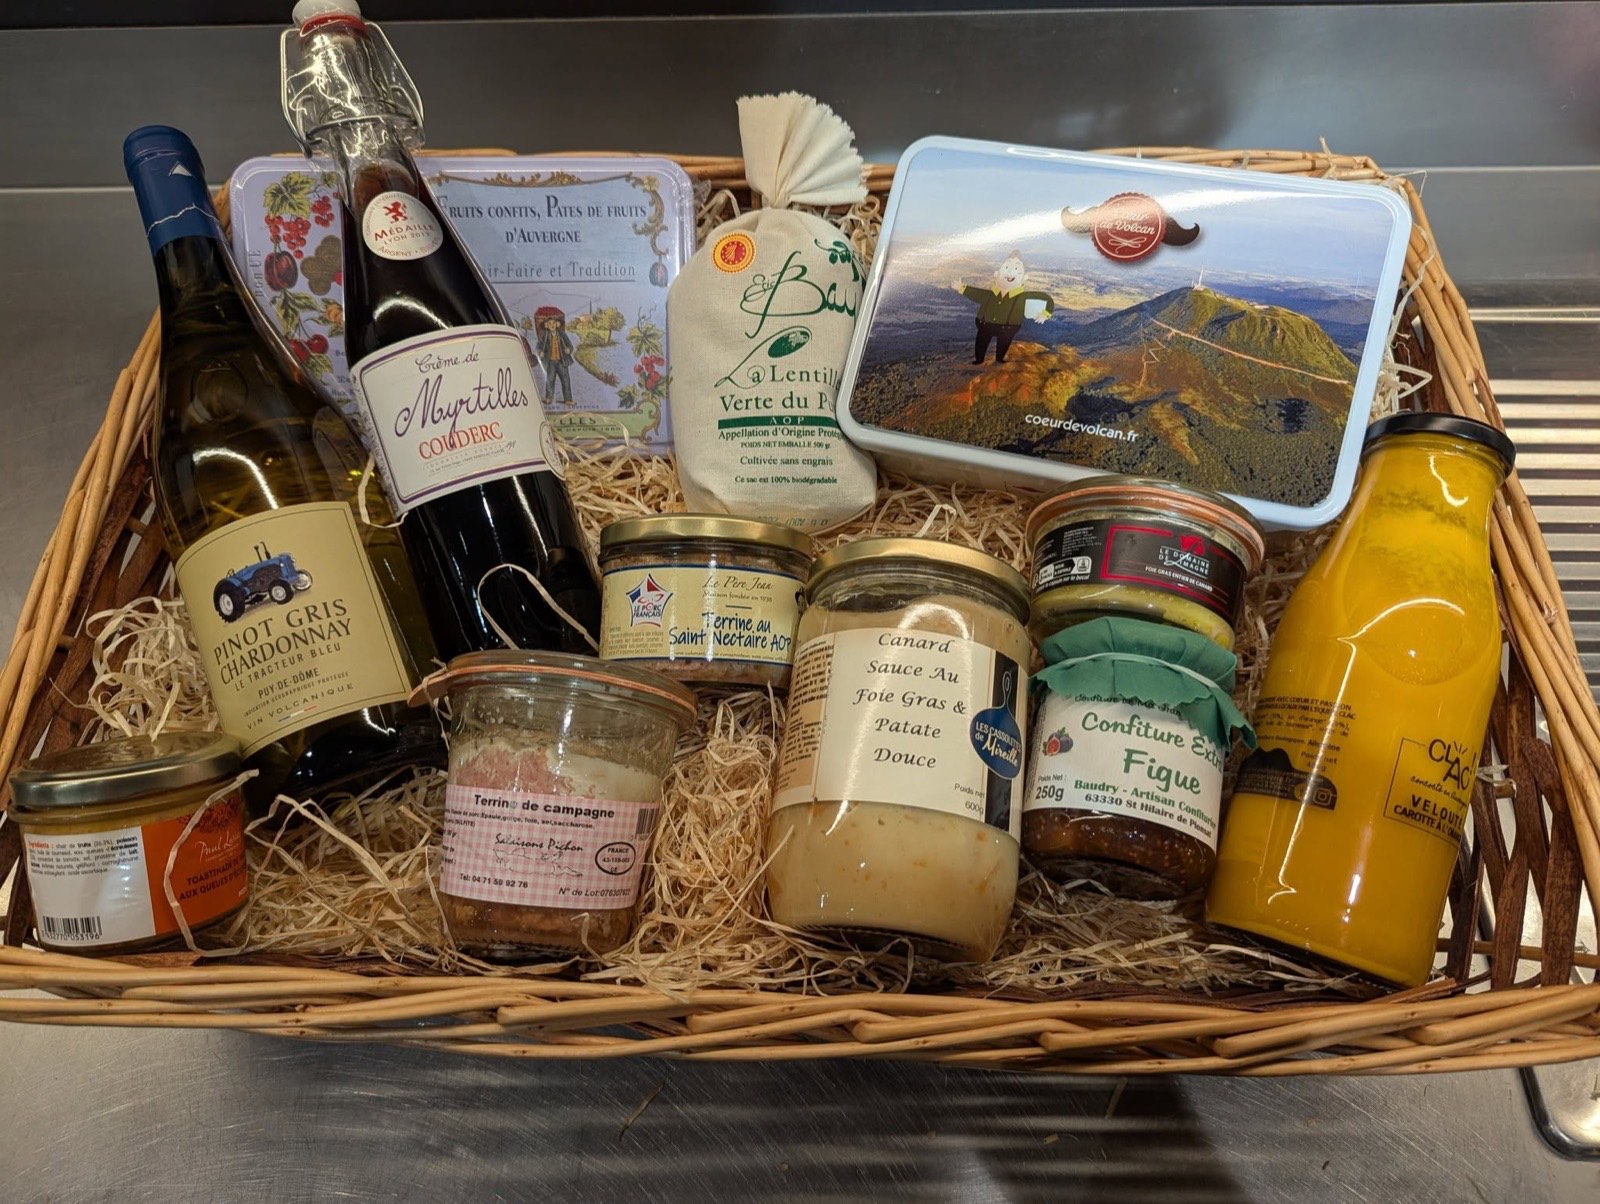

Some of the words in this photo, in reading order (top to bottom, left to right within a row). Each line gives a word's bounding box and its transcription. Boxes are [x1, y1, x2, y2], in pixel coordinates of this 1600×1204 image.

[1099, 219, 1113, 229] de
[1115, 220, 1155, 235] Volcan
[383, 234, 407, 245] LYON
[378, 245, 412, 257] ARGENT
[550, 264, 563, 277] et
[567, 260, 636, 277] Tradition
[415, 353, 461, 374] Crème
[462, 343, 480, 364] de
[394, 367, 529, 449] Myrtilles
[720, 394, 773, 412] Verte
[781, 391, 809, 410] du
[718, 426, 769, 442] Appellation
[771, 426, 816, 440] d'Origine
[1025, 413, 1139, 443] coeurdevolcan.fr
[418, 421, 504, 460] COUDERC
[739, 456, 778, 466] Cultivée
[780, 457, 799, 466] sans
[801, 457, 833, 467] engrais
[734, 475, 746, 483] Ce
[791, 476, 838, 486] biodégradable
[745, 576, 773, 592] Jean
[1145, 565, 1157, 574] FOIE
[1157, 568, 1172, 577] GRAS
[1172, 571, 1189, 583] ENTIER
[729, 591, 750, 600] fondée
[213, 618, 274, 666] PINOT
[285, 598, 348, 628] GRIS
[702, 611, 753, 632] Terrine
[757, 620, 771, 634] au
[669, 627, 707, 645] Saint
[712, 630, 768, 650] Nectaire
[770, 633, 791, 653] AOP
[878, 631, 957, 654] Canard
[220, 618, 351, 685] CHARDONNAY
[234, 679, 245, 692] LE
[248, 653, 304, 684] TRACTEUR
[310, 642, 341, 659] BLEU
[866, 660, 923, 678] Sauce
[928, 666, 960, 684] Au
[247, 716, 264, 731] VIN
[268, 683, 354, 718] VOLCANIQUE
[852, 688, 895, 706] Foie
[901, 690, 947, 711] Gras
[952, 700, 968, 715] &
[875, 717, 942, 739] Patate
[976, 721, 989, 734] LES
[1081, 712, 1185, 749] Confiture
[873, 747, 937, 769] Douce
[975, 731, 984, 742] de
[982, 733, 1019, 768] Mireille
[1052, 774, 1063, 782] Net
[1123, 747, 1201, 795] Figue
[954, 782, 974, 796] Poids
[974, 789, 986, 799] net
[1035, 785, 1065, 802] 250g
[1074, 779, 1119, 796] Baudry
[1130, 787, 1176, 808] Artisan
[521, 799, 540, 812] de
[543, 804, 616, 820] campagne
[964, 800, 985, 816] 600g
[1085, 793, 1123, 807] 63330
[1125, 799, 1138, 810] St
[1140, 804, 1174, 821] Hilaire
[1176, 813, 1188, 826] de
[1393, 805, 1437, 828] CAROTTE
[179, 887, 199, 901] AUX
[199, 876, 230, 895] QUEUES
[460, 872, 472, 883] Tel:
[471, 874, 481, 884] 04
[482, 876, 492, 886] 71
[505, 878, 517, 889] 92
[518, 879, 529, 889] 76
[558, 886, 571, 897] N°
[571, 886, 583, 897] de
